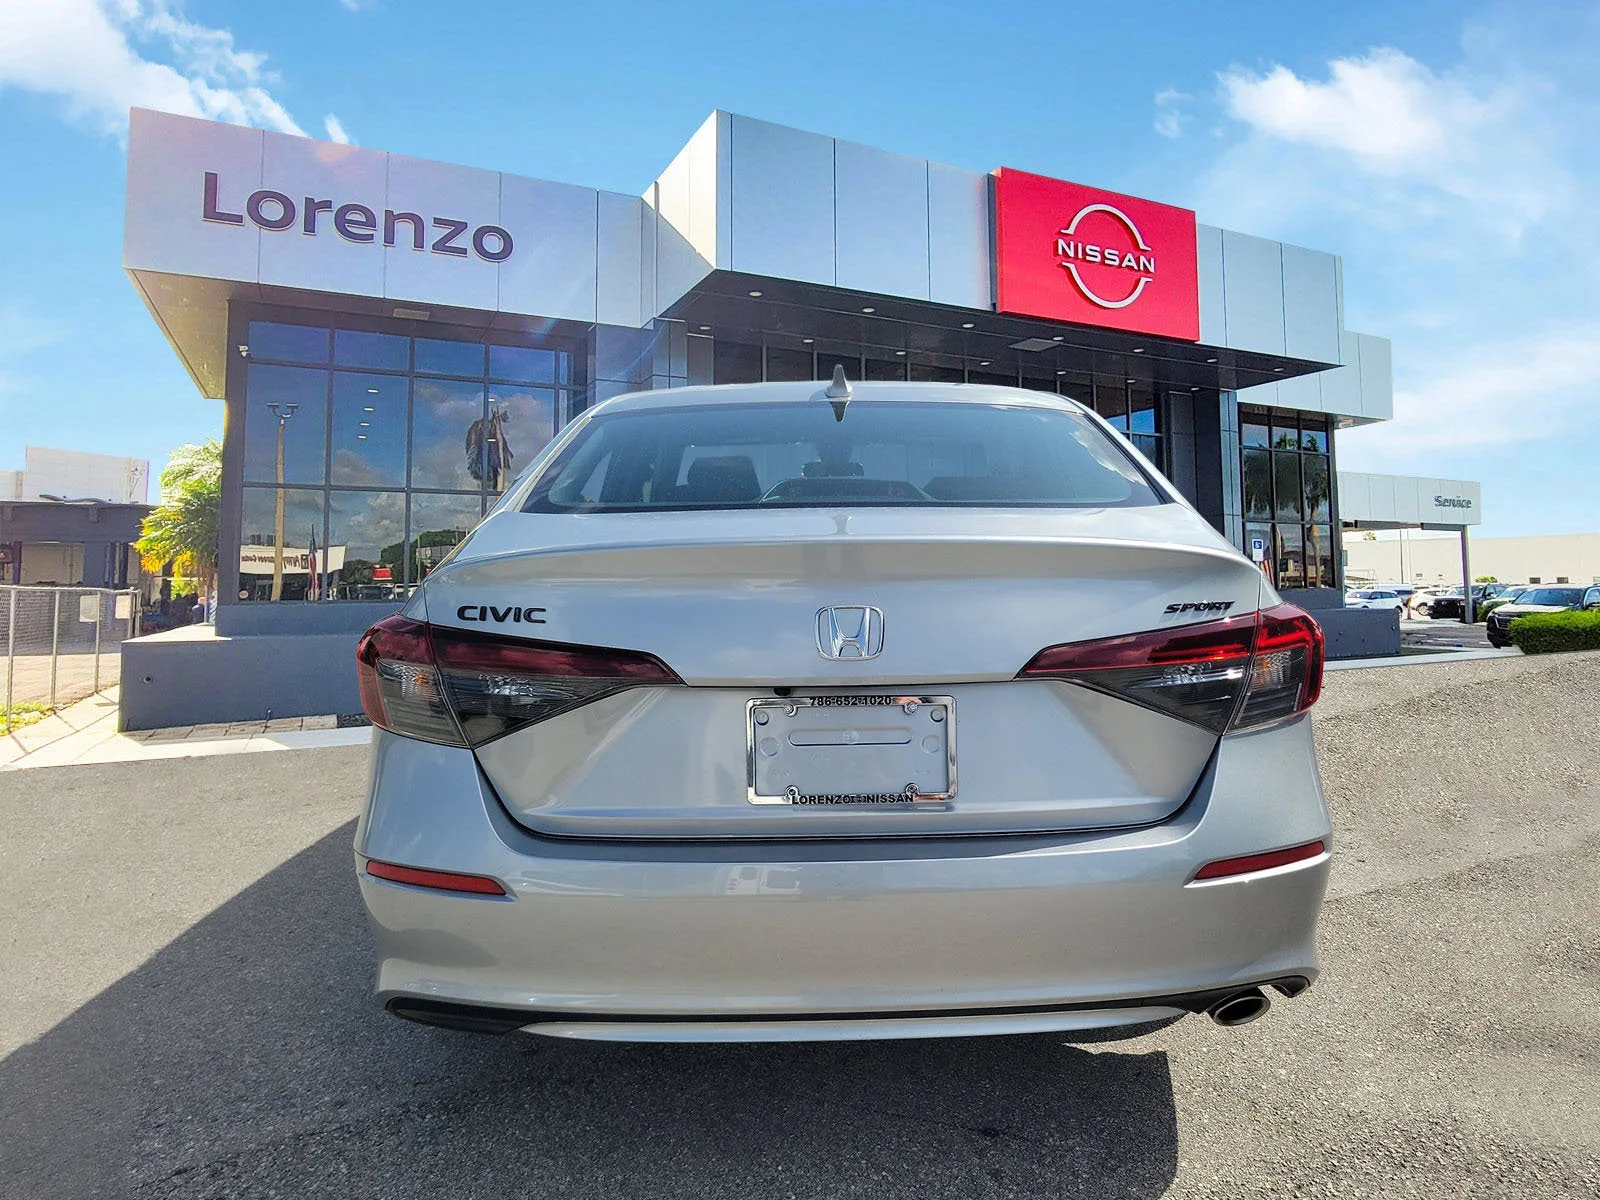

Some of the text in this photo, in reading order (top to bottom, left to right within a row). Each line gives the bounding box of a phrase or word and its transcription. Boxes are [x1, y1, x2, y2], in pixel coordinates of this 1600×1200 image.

[202, 171, 514, 263] Lorenzo
[1057, 238, 1155, 273] NISSAN
[1434, 495, 1472, 509] Service
[457, 605, 547, 624] CIVIC
[1163, 601, 1236, 614] SPORT
[809, 695, 892, 707] 786-652-1020
[791, 793, 914, 805] LORENZO NISSAN
